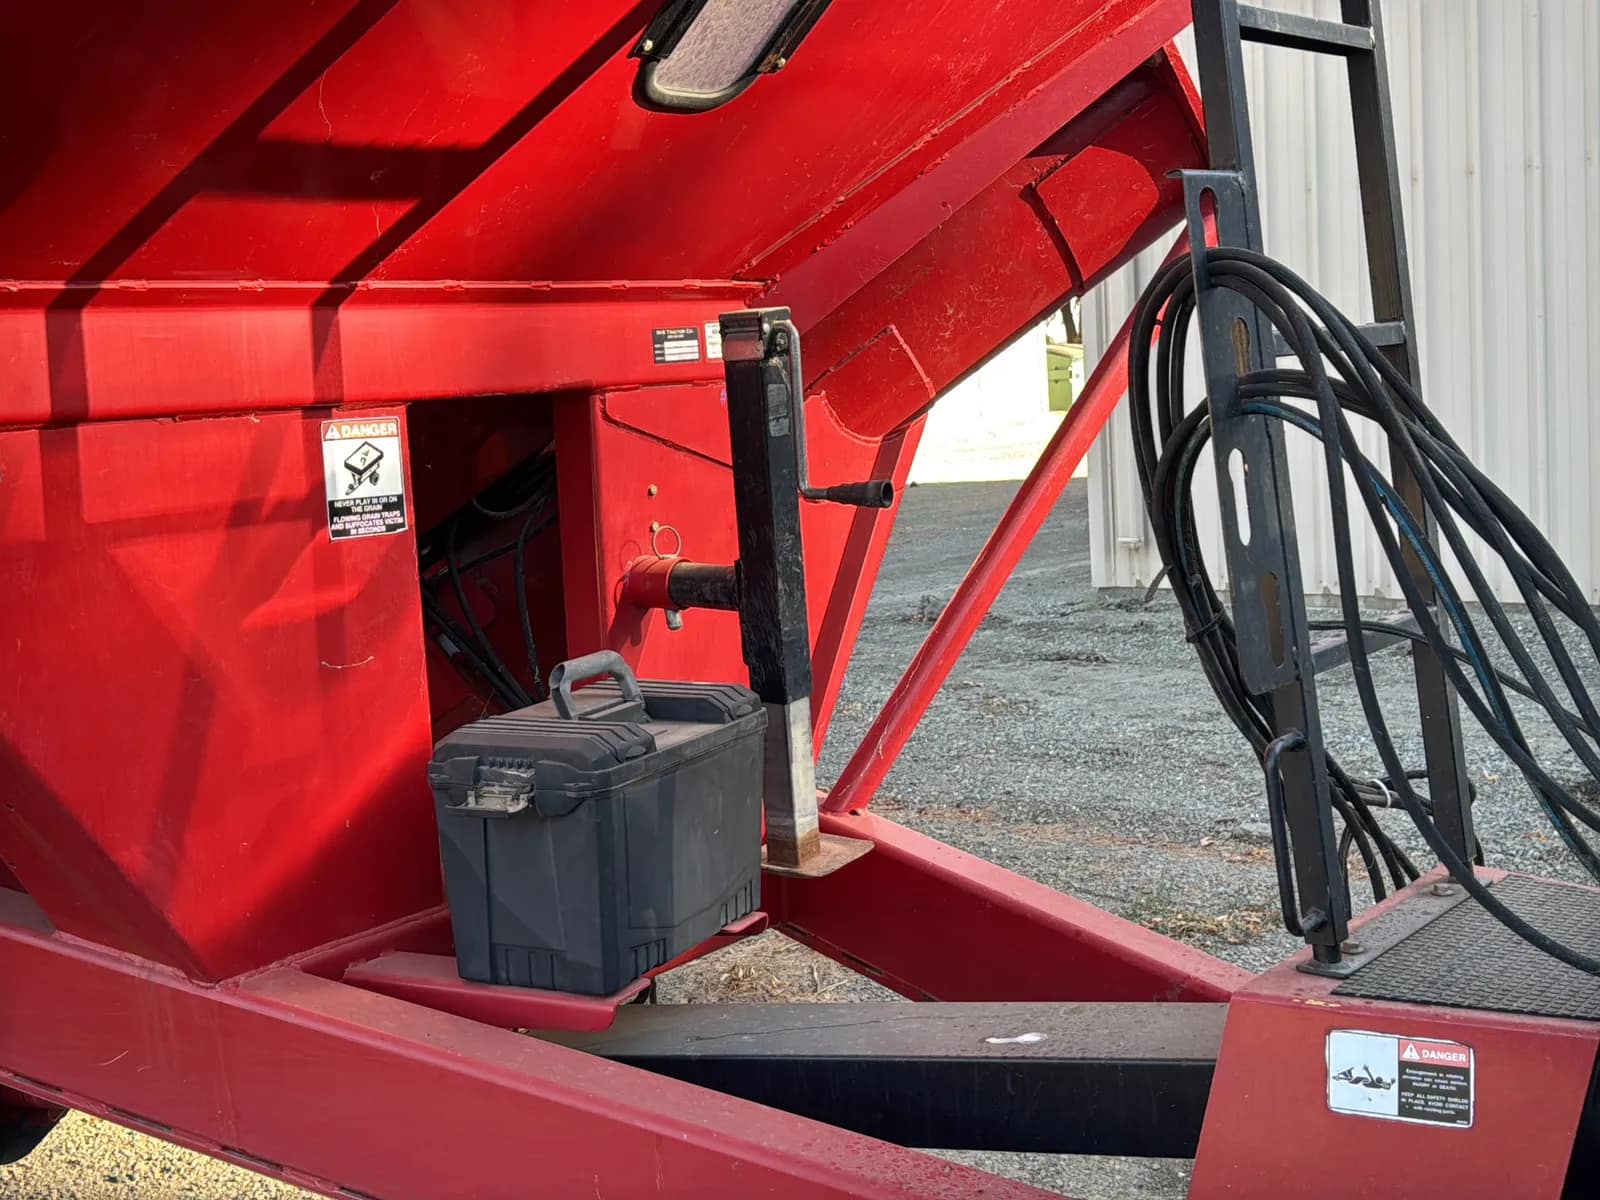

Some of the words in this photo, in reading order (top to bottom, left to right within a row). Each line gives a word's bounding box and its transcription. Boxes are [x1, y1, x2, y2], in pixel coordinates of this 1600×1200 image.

[341, 422, 398, 438] DANGER
[334, 500, 354, 508] NEVER
[356, 498, 371, 506] PLAY
[379, 496, 388, 504] OR
[364, 504, 383, 512] GRAIN
[333, 514, 361, 523] FLOWING
[362, 512, 381, 520] GRAIN
[382, 510, 400, 518] TRAPS
[345, 519, 384, 529] SUFFOCATES
[358, 525, 386, 534] SECONDS
[1422, 1049, 1466, 1062] DANGER
[1445, 1102, 1469, 1110] CONTACT
